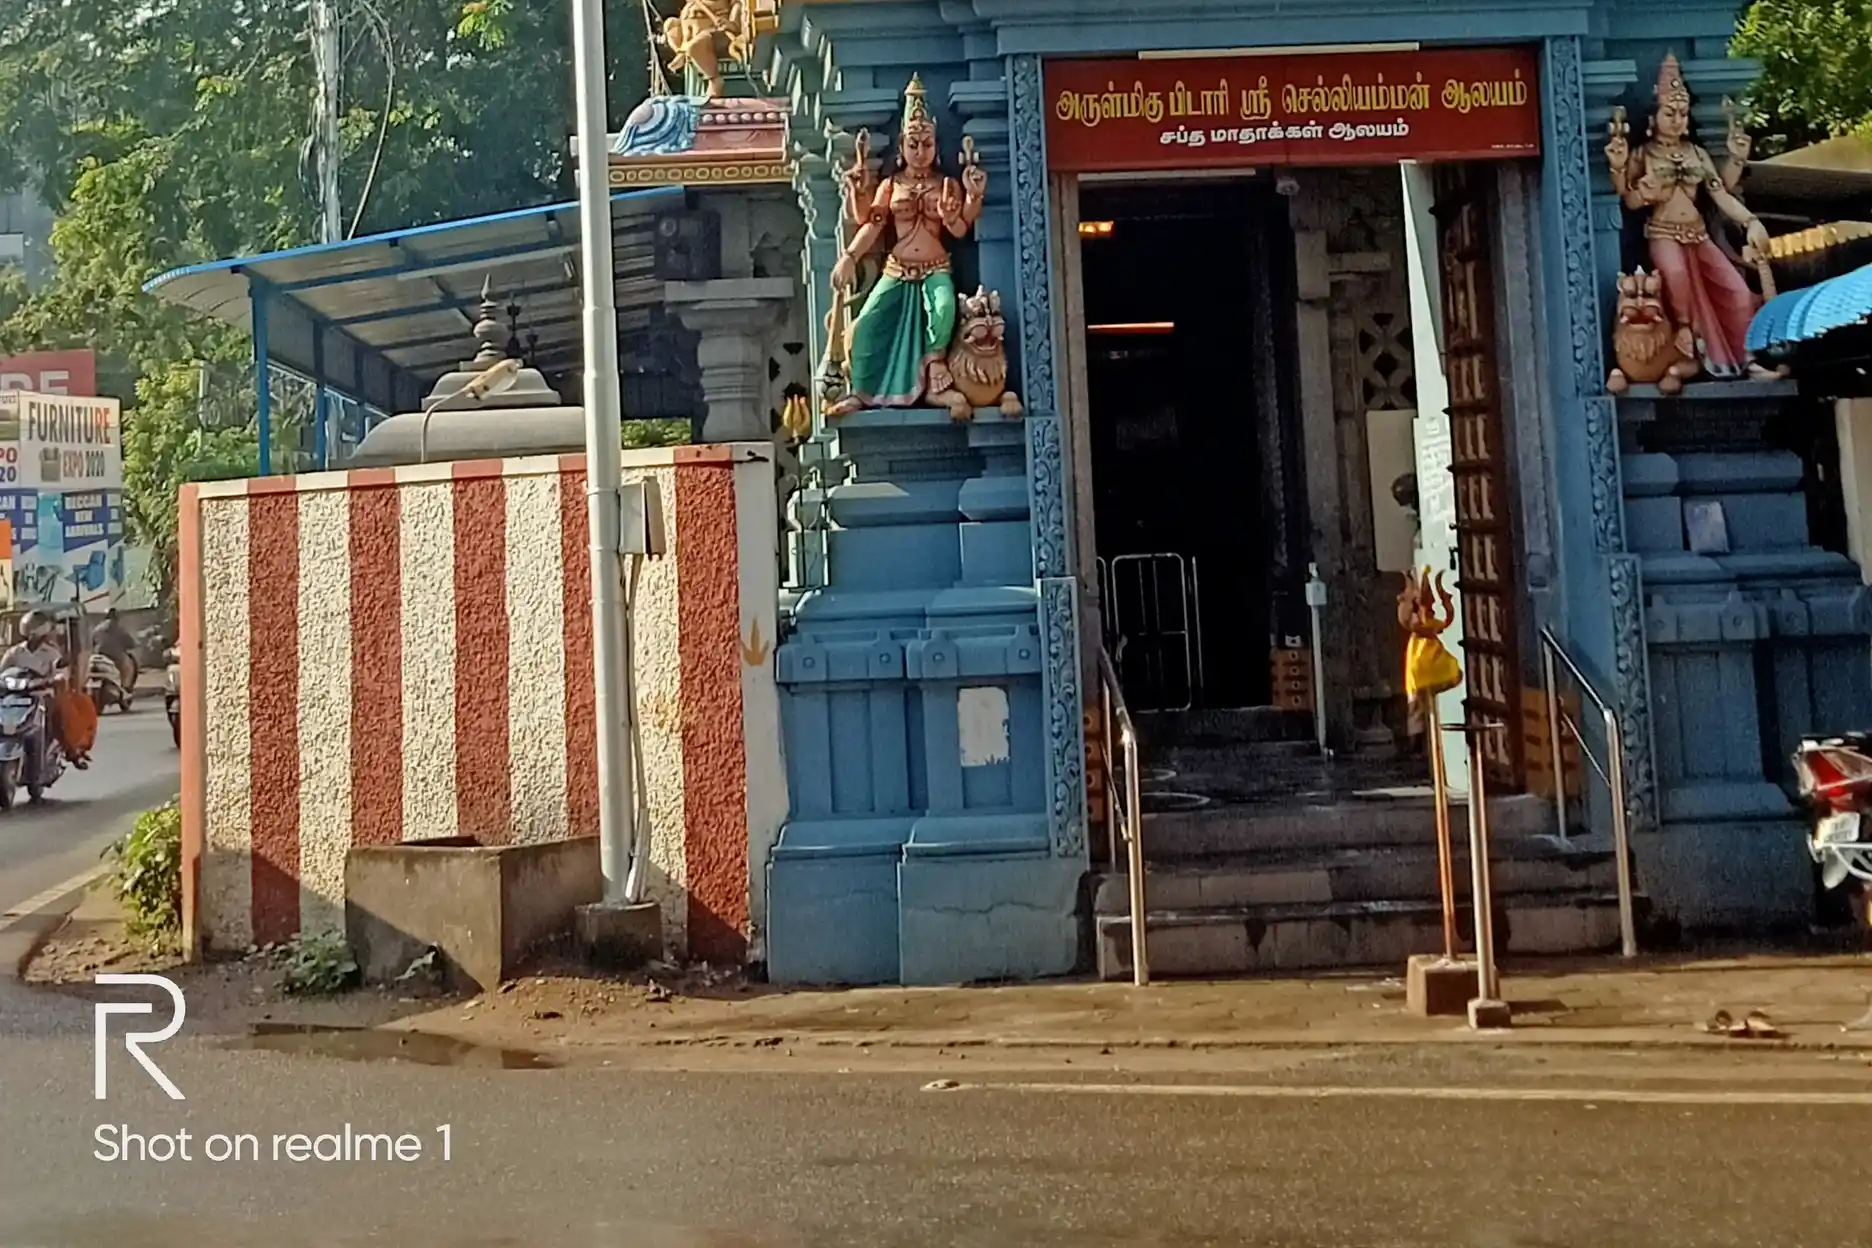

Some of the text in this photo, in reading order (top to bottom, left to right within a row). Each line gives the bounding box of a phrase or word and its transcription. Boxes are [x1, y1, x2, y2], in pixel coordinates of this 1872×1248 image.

[1056, 80, 1163, 127] அருள்மிகு
[1169, 78, 1229, 116] பிடாரி
[1282, 71, 1430, 113] செல்லியம்மன்
[1441, 68, 1527, 114] ஆலயம்
[1160, 117, 1409, 146] சப்த மாதாக்கள் ஆலயம்
[28, 401, 111, 444] FURNITURE
